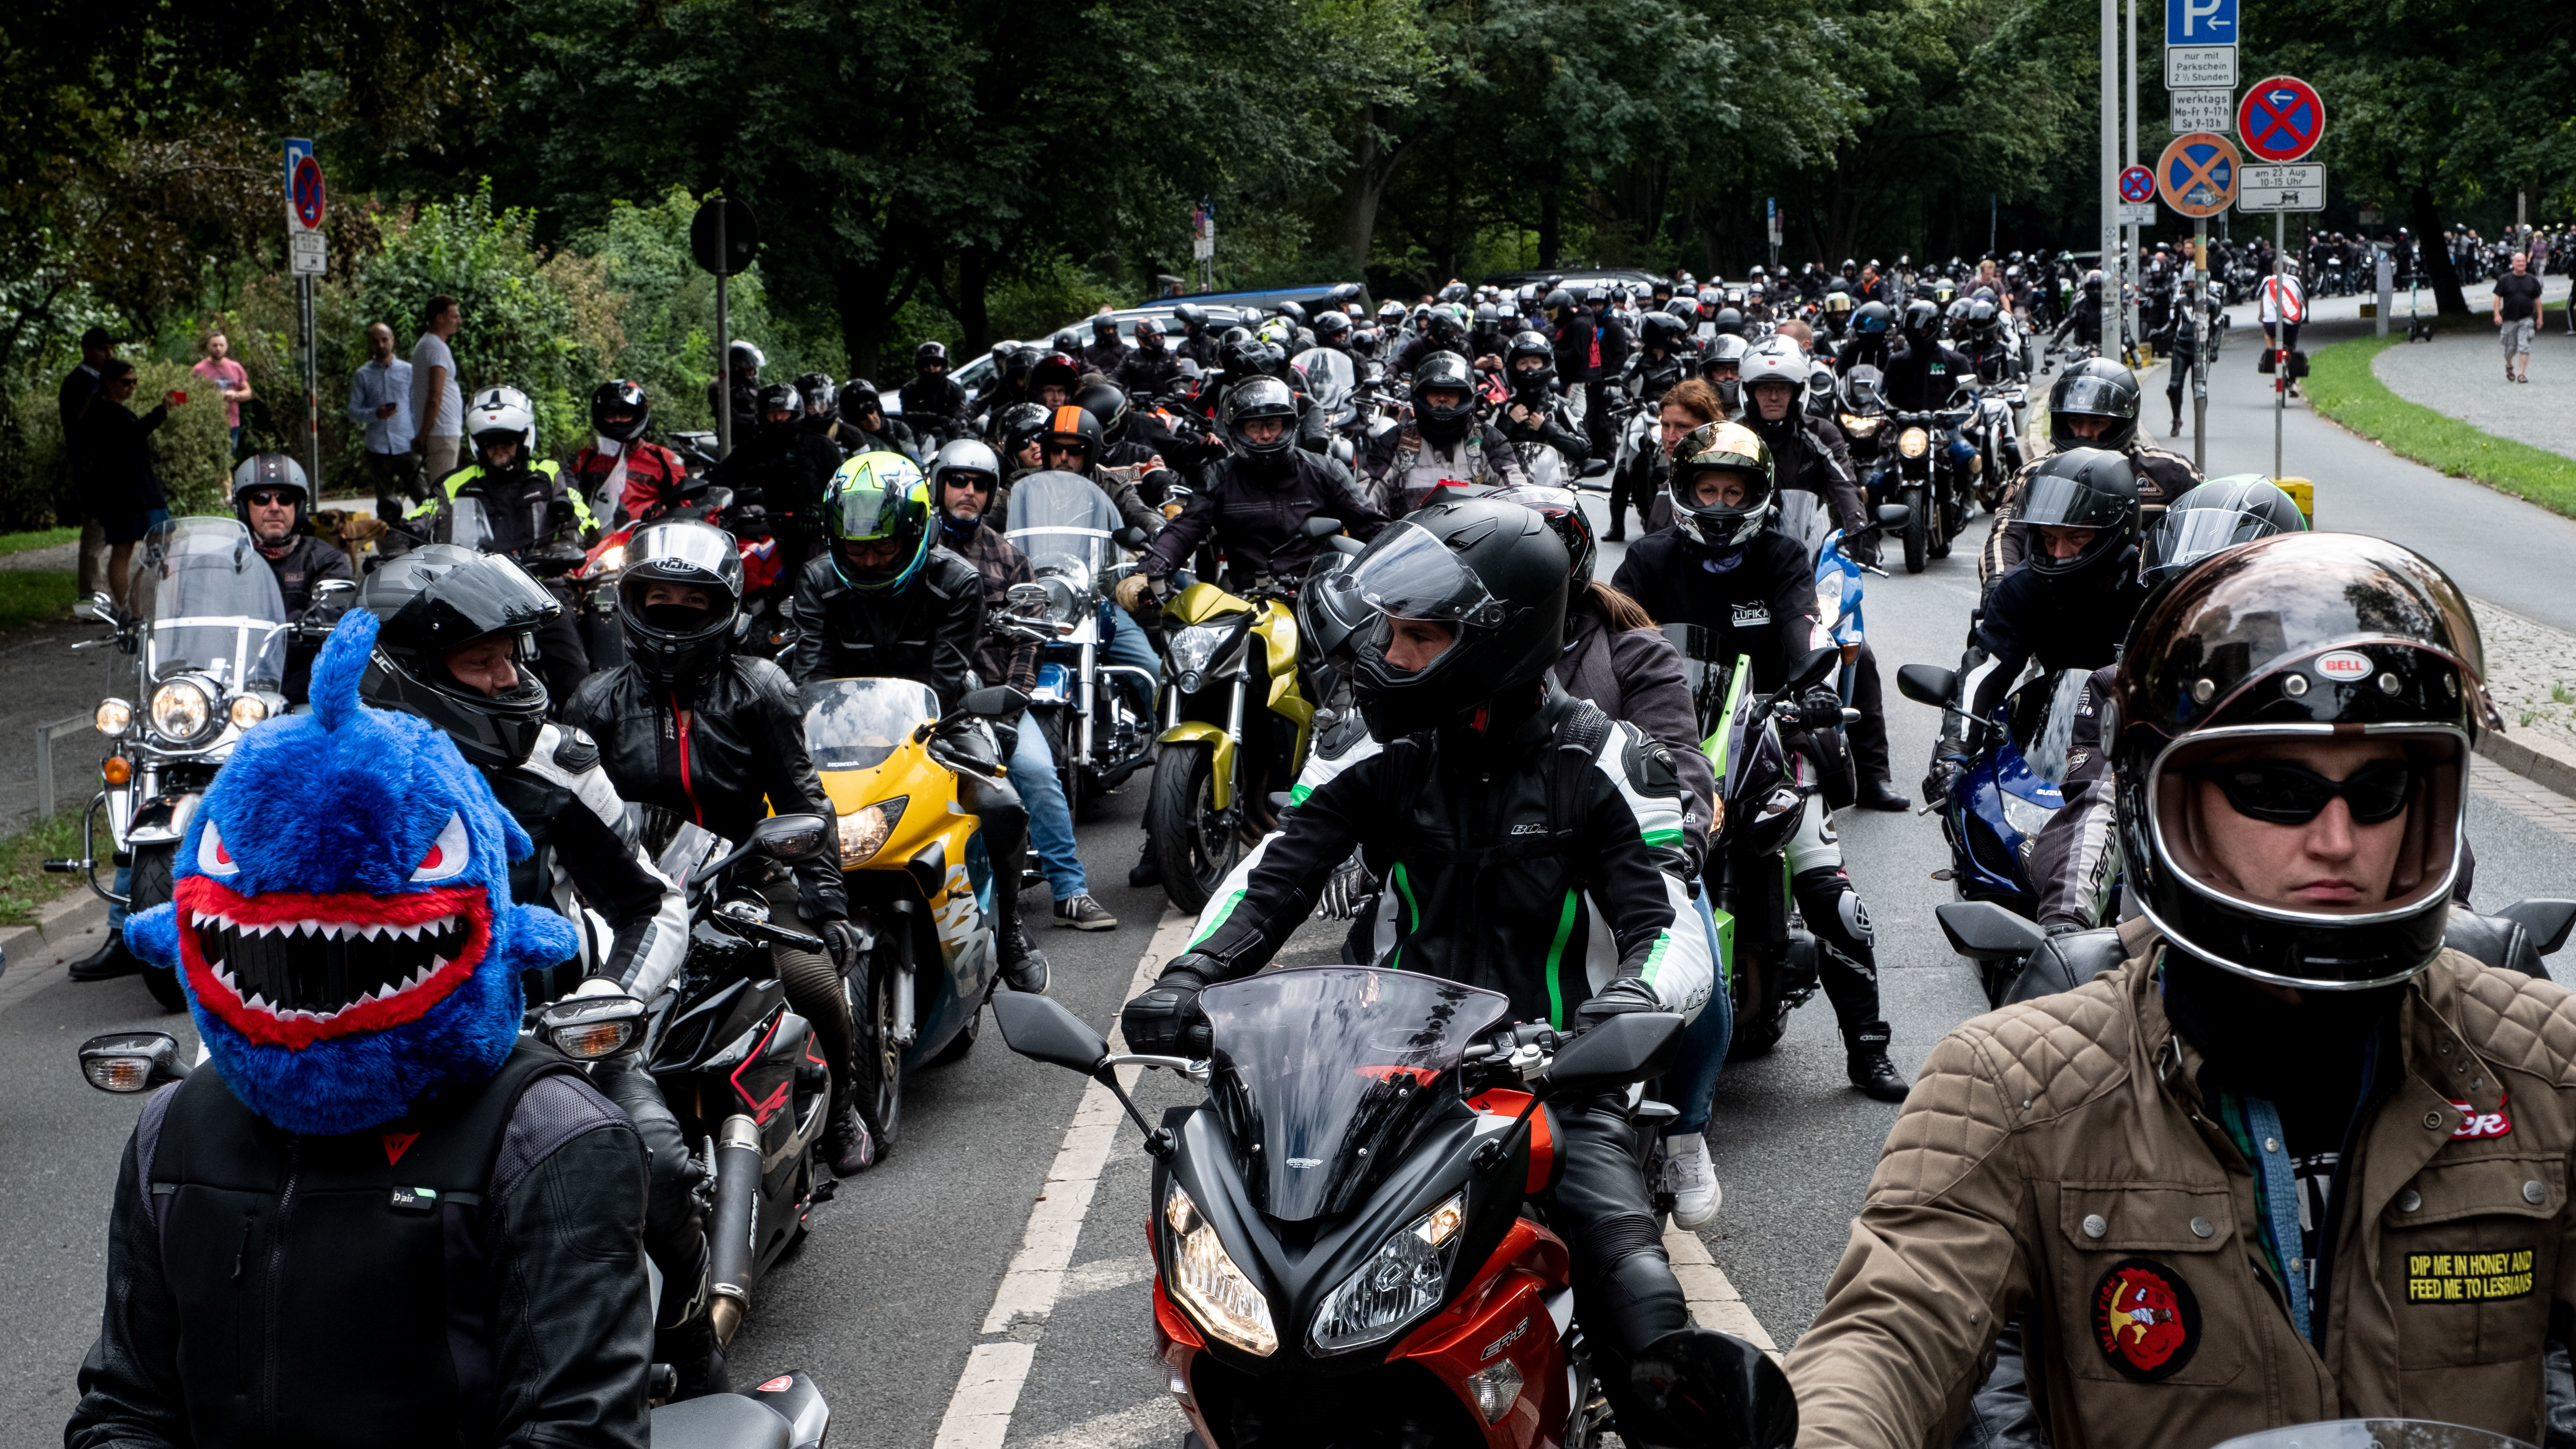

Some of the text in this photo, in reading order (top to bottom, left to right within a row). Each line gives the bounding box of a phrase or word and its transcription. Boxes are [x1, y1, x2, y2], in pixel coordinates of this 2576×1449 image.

[2184, 0, 2221, 36] P
[2177, 62, 2227, 70] Parkschein
[2175, 73, 2180, 82] 2
[2192, 73, 2229, 81] Stunden
[2177, 94, 2227, 105] werktags
[2175, 107, 2228, 116] Mo-Fr 9-17 h
[2182, 118, 2221, 128] Sa 9-13 h
[2260, 178, 2283, 186] 10-15
[659, 560, 695, 571] HJC
[1735, 608, 1768, 620] LUFIKA
[2326, 660, 2363, 671] BELL
[2410, 1250, 2532, 1276] DIP ME IN HONEY AND
[2410, 1272, 2532, 1300] FEED ME TO LESBIANS
[2098, 1276, 2118, 1353] HELLFISH
